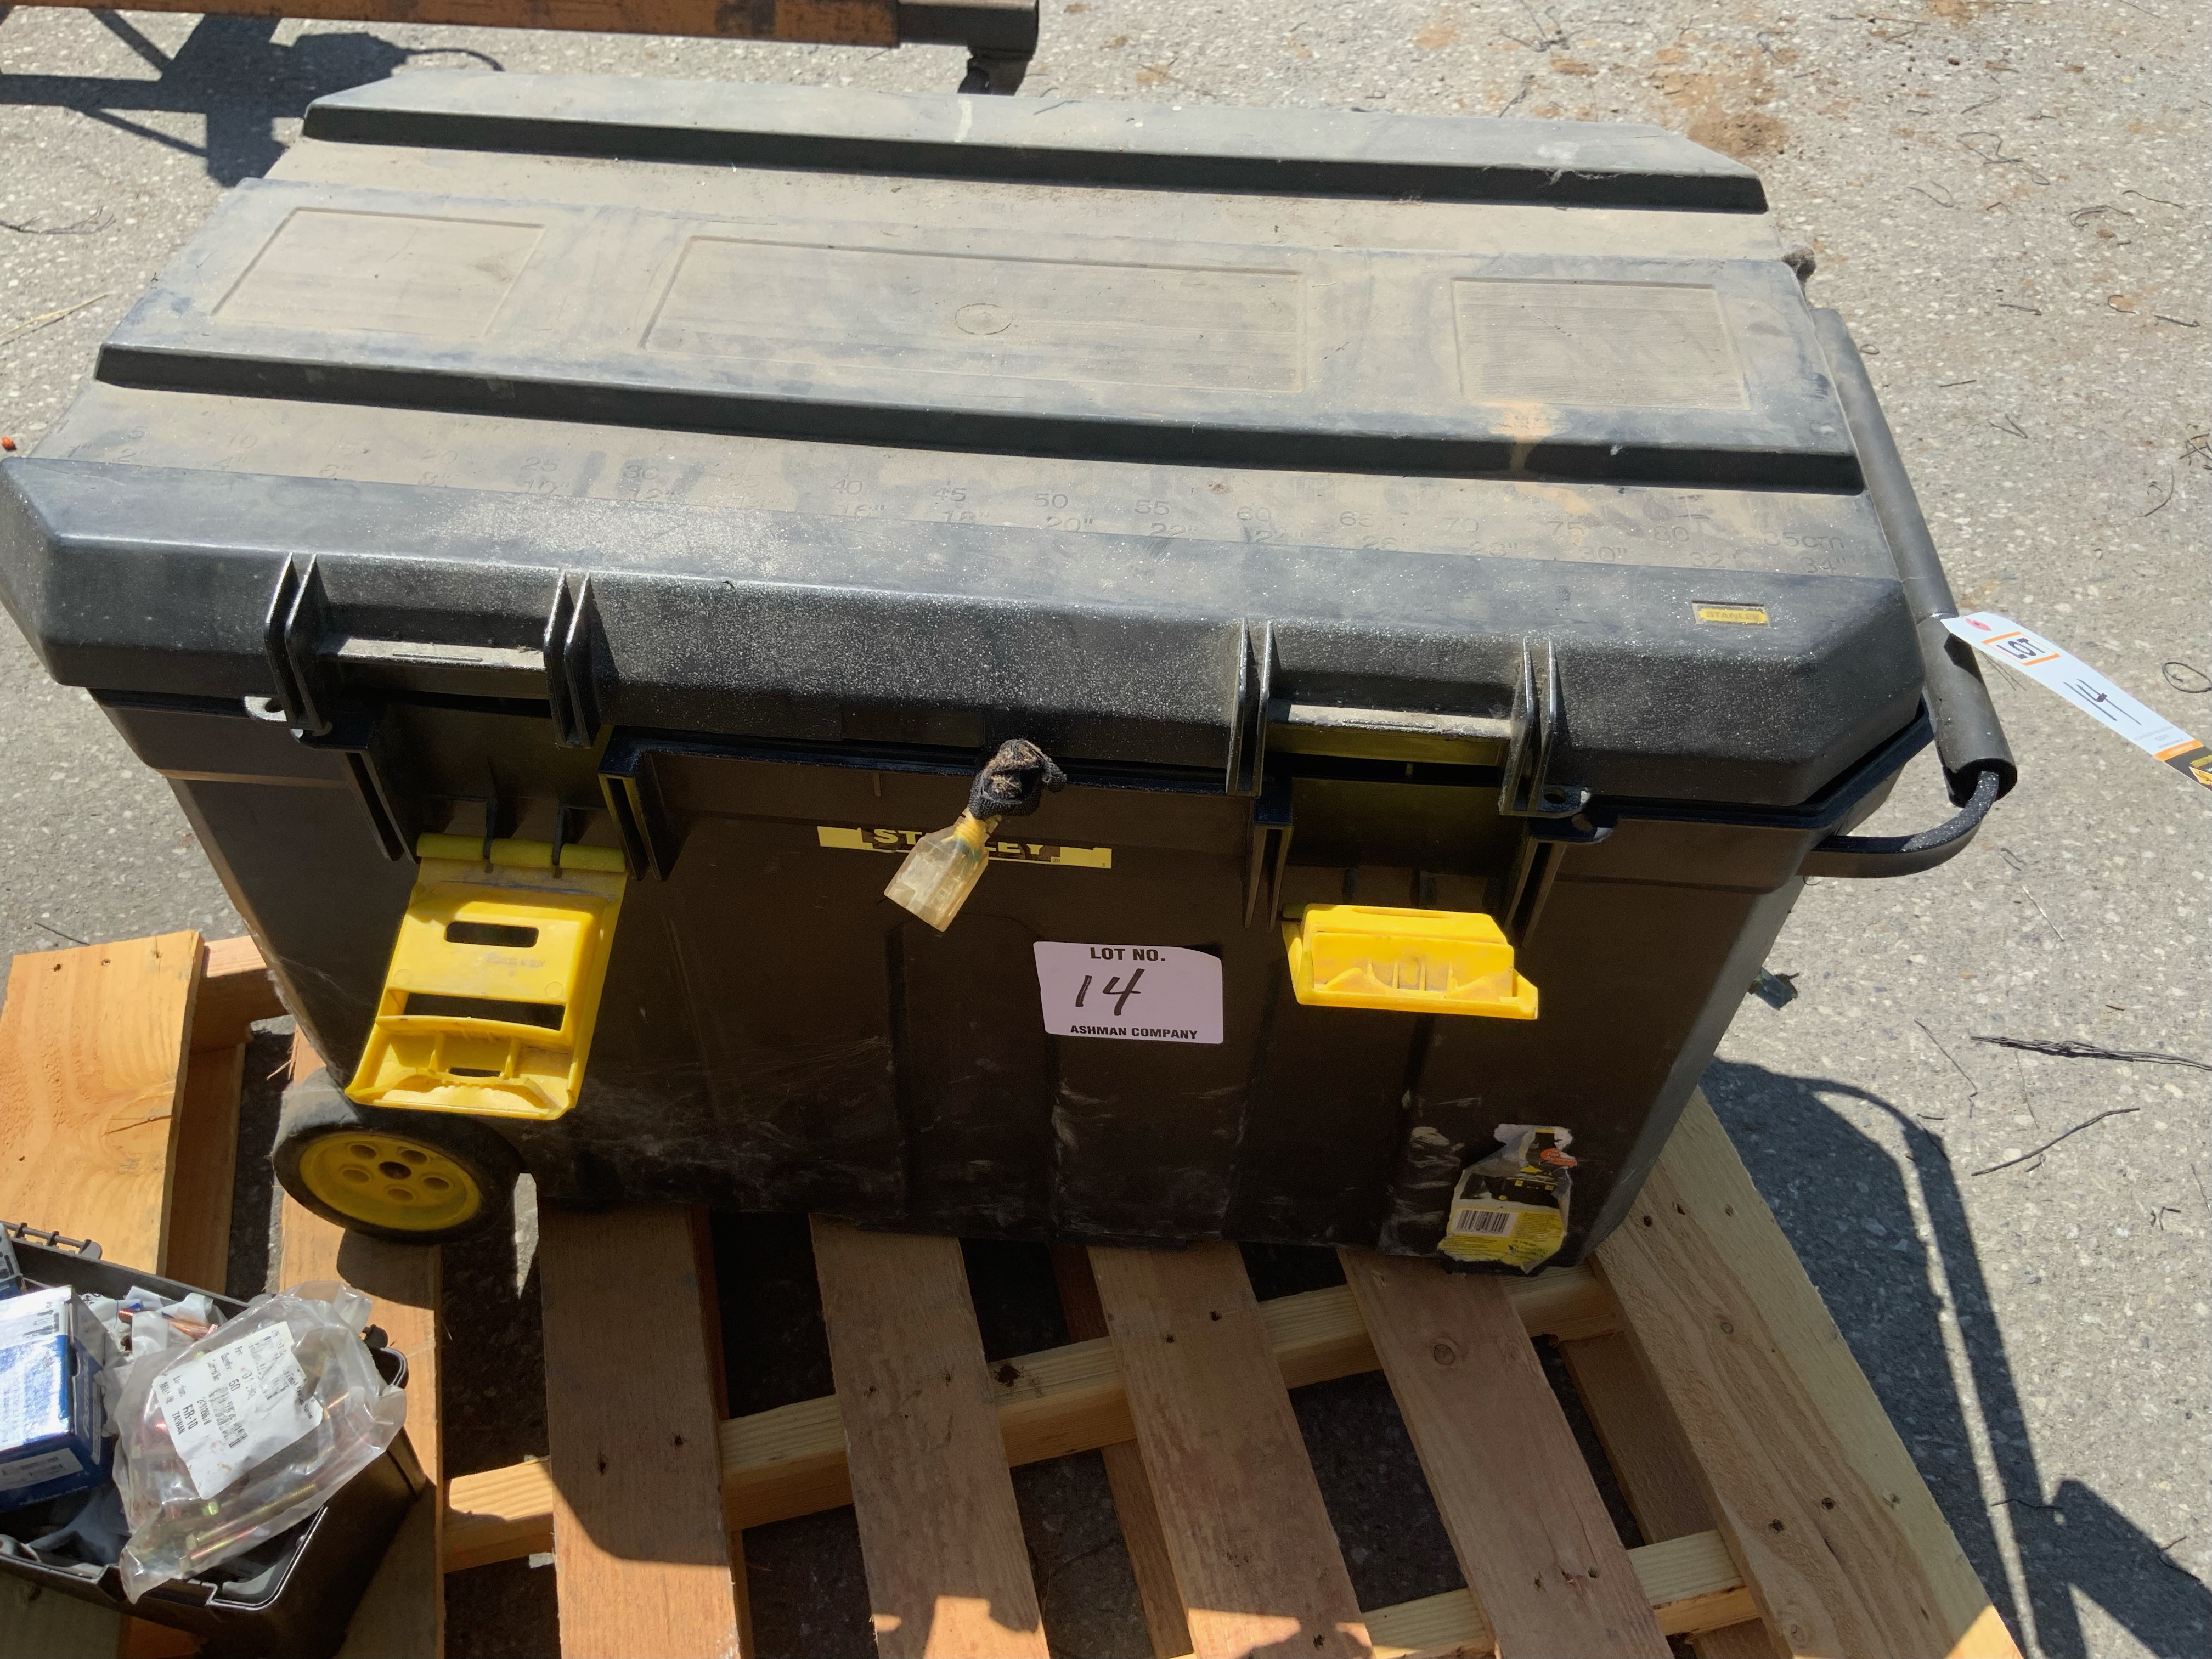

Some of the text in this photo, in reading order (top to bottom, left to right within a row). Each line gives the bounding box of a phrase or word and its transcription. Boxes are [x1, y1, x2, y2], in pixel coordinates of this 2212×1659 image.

[829, 479, 864, 495] 40
[933, 487, 967, 503] 45
[1034, 493, 1069, 509] 50
[1133, 499, 1170, 516] 55
[1236, 505, 1272, 522] 60
[1339, 510, 1374, 528] 65
[1996, 637, 2046, 659] LOT
[1090, 947, 1166, 961] LOT NO.
[1075, 968, 1146, 1016] 14
[1070, 1025, 1198, 1039] ASHMAN COMPANY
[228, 1378, 240, 1391] 50
[172, 1410, 185, 1435] TAIWAN
